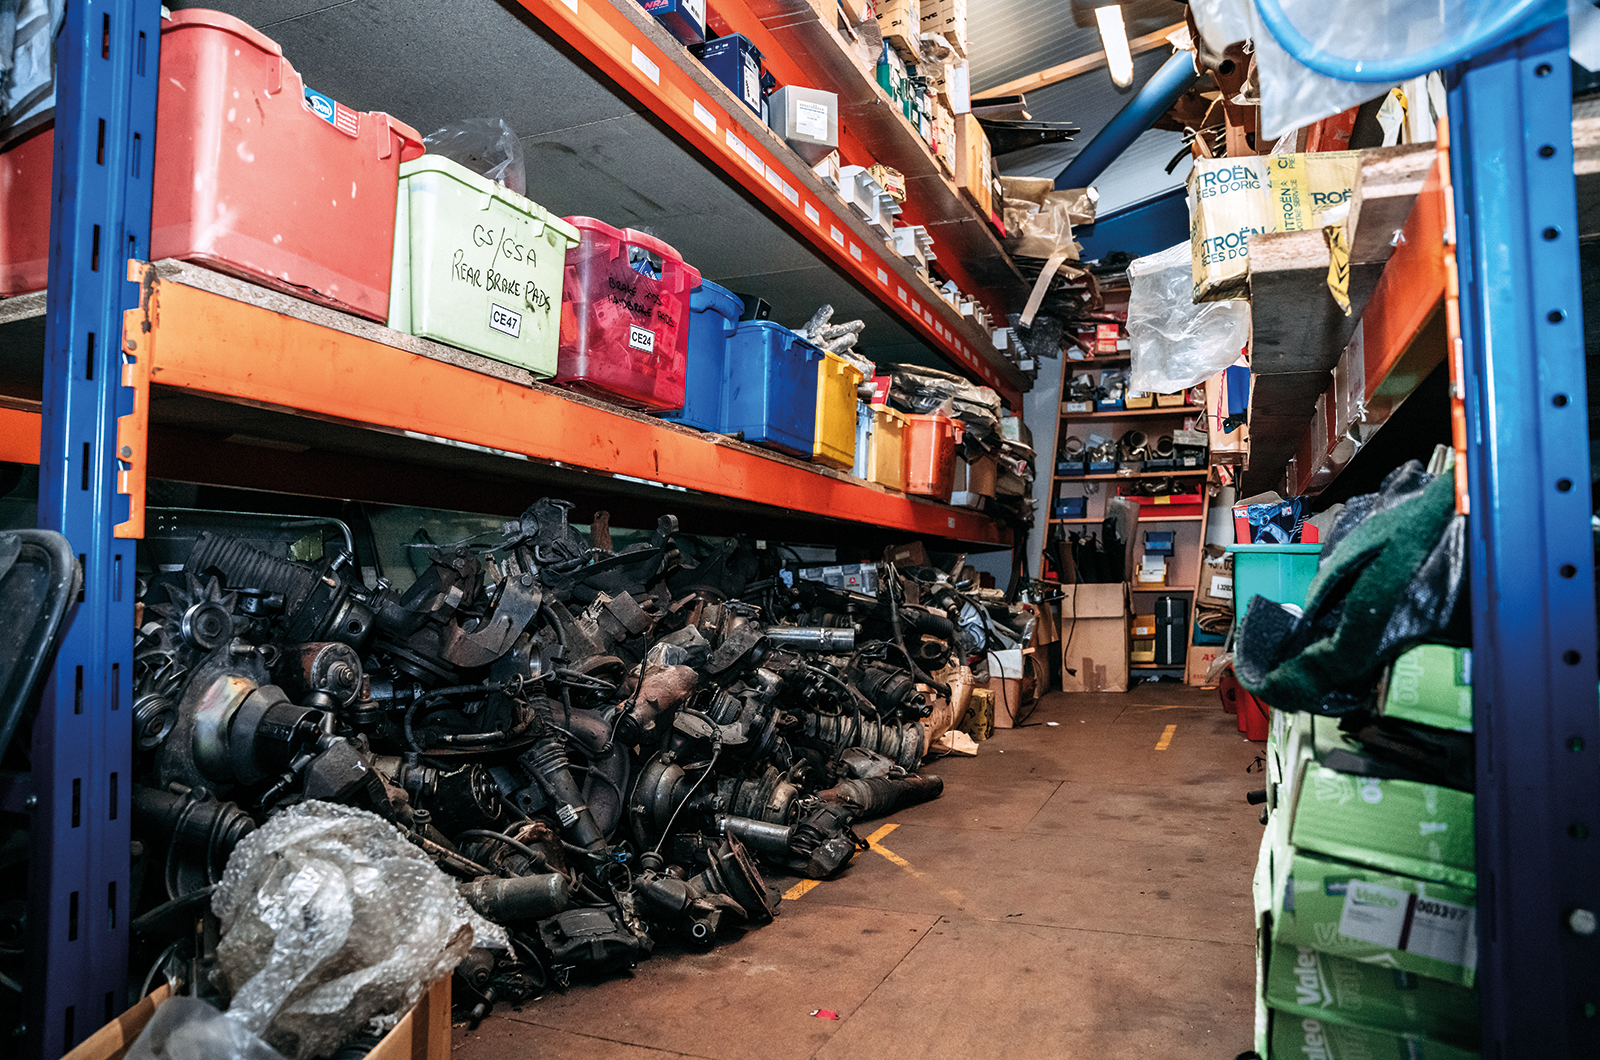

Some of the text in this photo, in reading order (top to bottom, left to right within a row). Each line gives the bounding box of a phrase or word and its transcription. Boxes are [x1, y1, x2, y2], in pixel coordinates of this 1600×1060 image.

[451, 248, 482, 288] REAR
[485, 268, 521, 297] BRAKE
[493, 310, 518, 330] CE47
[631, 331, 652, 346] CE24
